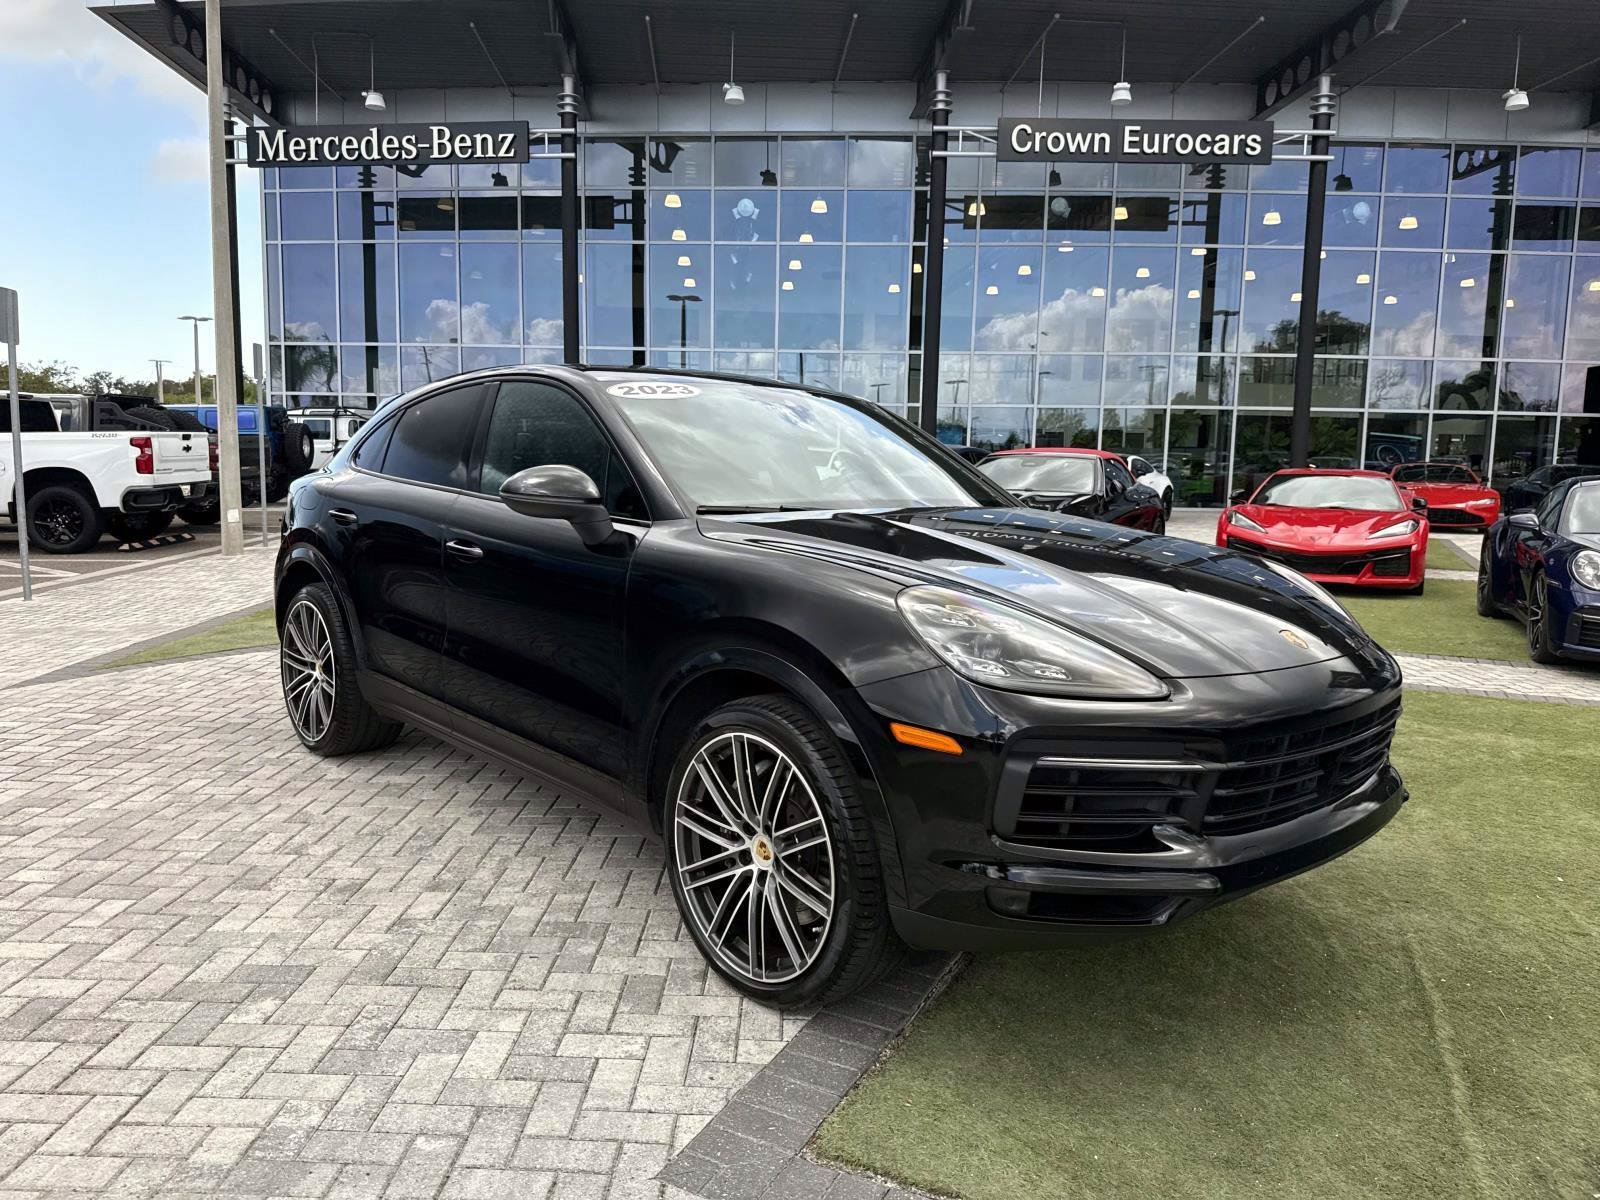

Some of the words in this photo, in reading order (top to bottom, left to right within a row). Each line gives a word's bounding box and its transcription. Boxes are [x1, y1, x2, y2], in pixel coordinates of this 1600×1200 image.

[255, 126, 515, 162] Mercedes-Benz
[1010, 123, 1111, 153] Crown
[1123, 125, 1262, 155] Eurocars
[617, 385, 695, 396] 2023
